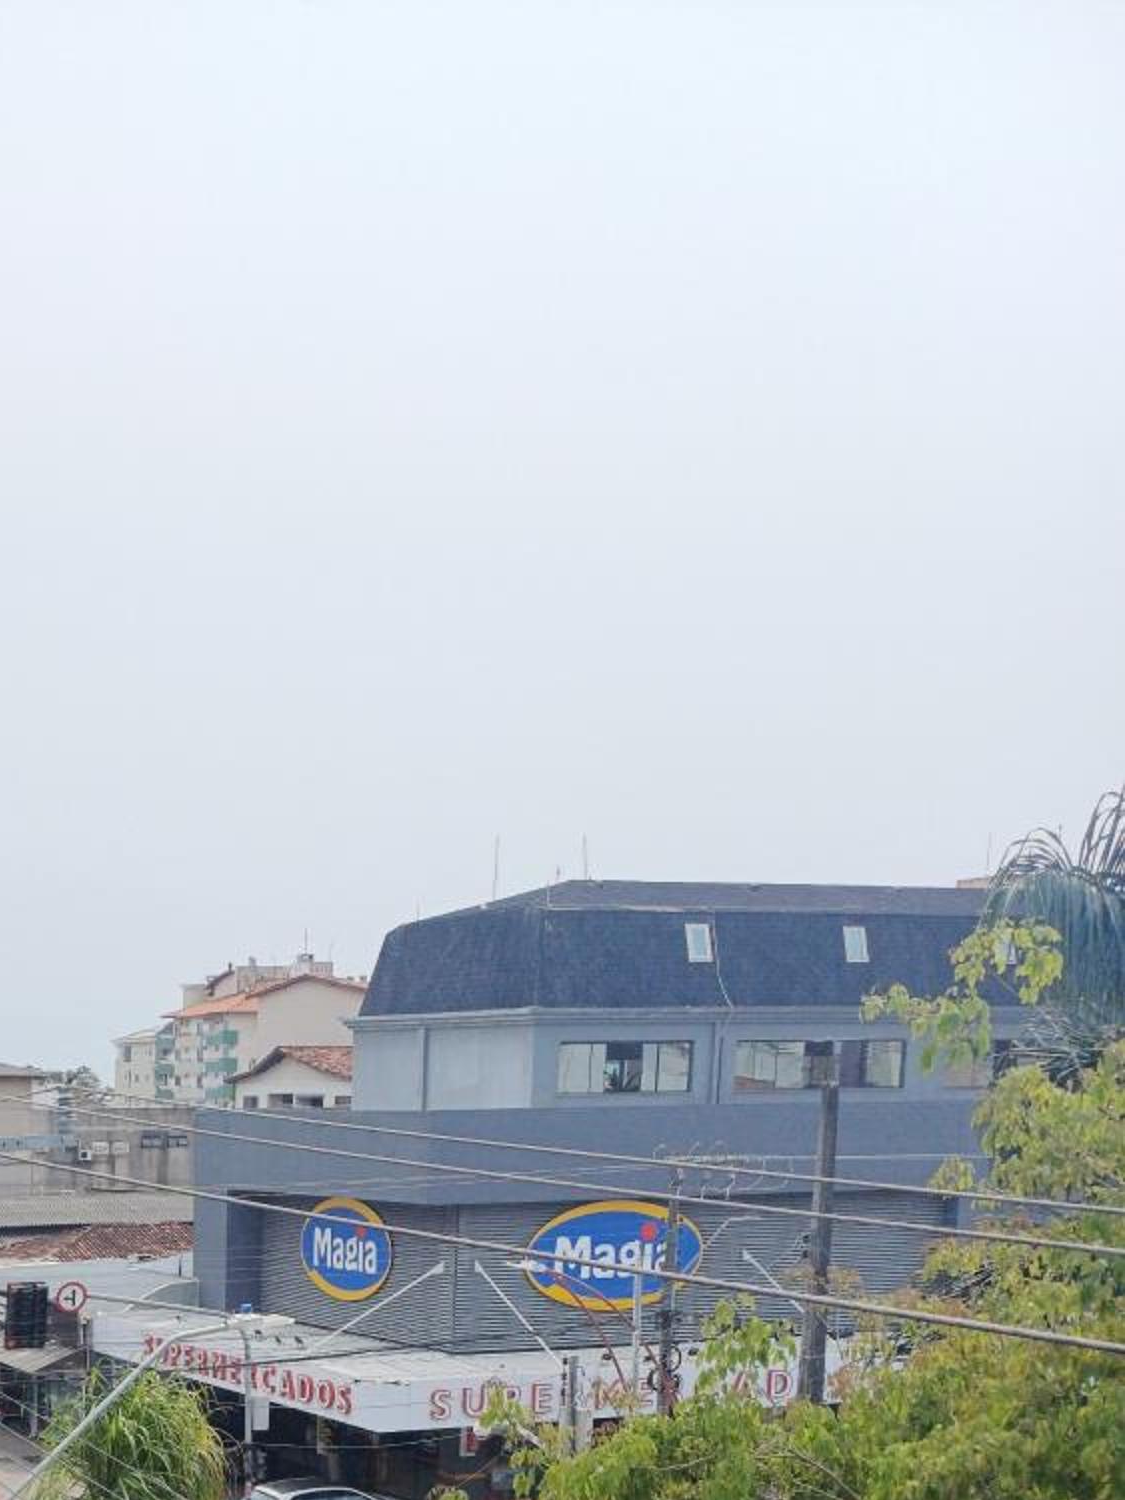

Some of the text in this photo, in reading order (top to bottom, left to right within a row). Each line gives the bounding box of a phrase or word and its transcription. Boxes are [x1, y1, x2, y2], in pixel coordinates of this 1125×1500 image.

[312, 1226, 378, 1275] Magia
[555, 1226, 672, 1280] Magia
[429, 1368, 841, 1422] SUPEMEAD
